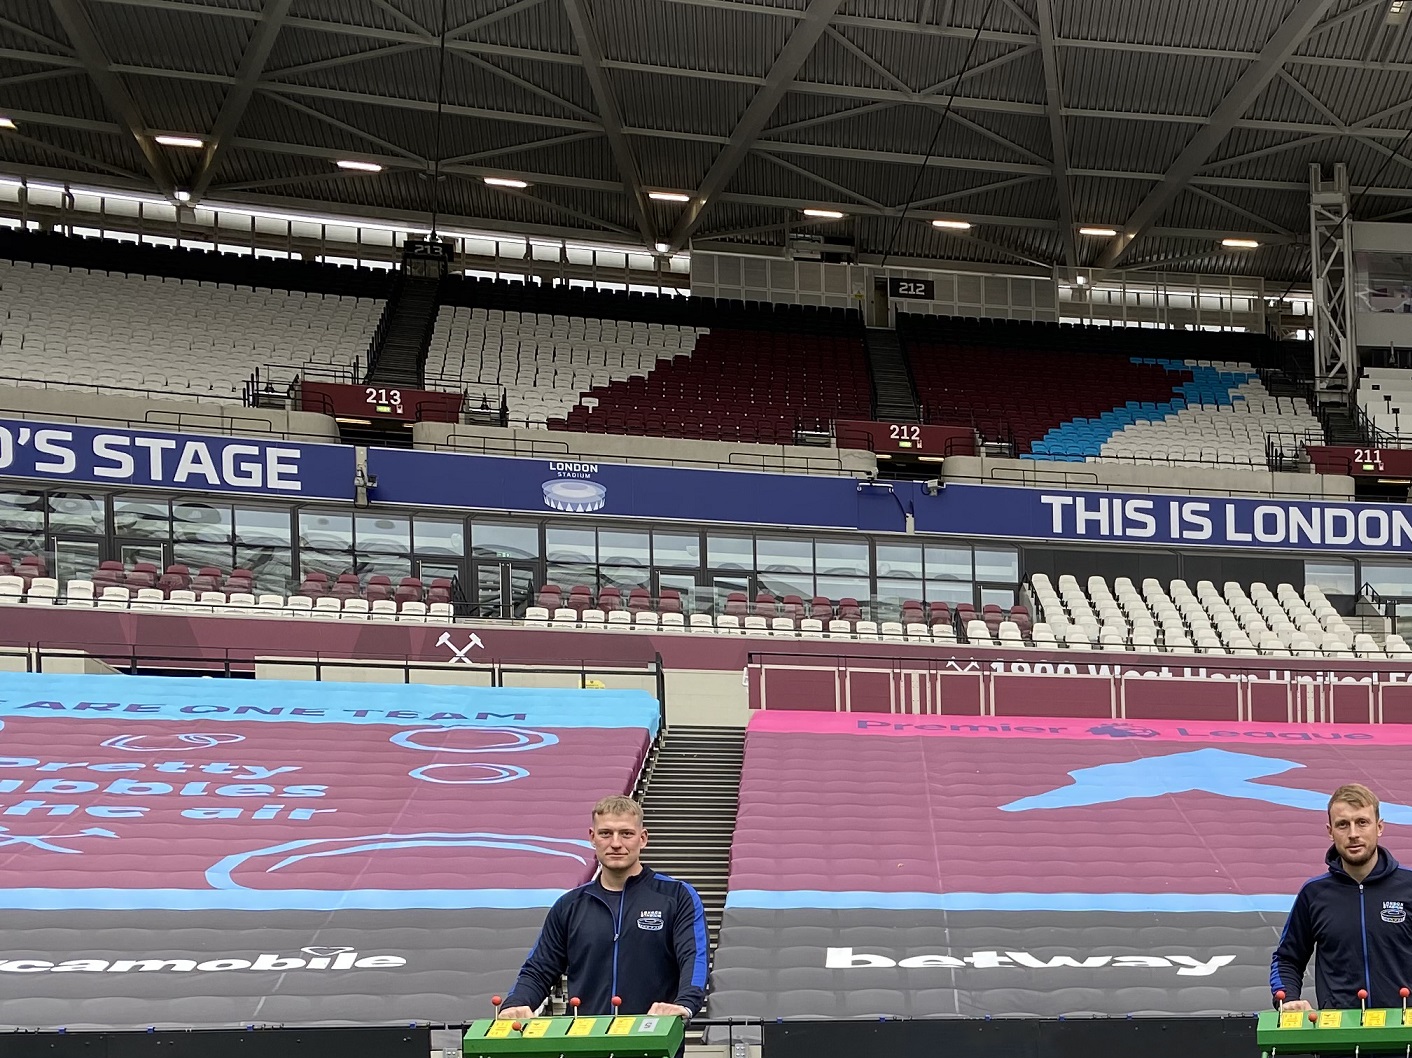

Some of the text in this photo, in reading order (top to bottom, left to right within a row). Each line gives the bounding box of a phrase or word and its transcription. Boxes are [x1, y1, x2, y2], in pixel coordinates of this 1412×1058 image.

[414, 244, 442, 256] 213
[899, 282, 925, 296] 212
[365, 387, 402, 405] 213
[889, 424, 921, 440] 212
[93, 434, 302, 491] STAGE
[1354, 448, 1382, 463] 211
[549, 461, 598, 473] LONDON
[557, 471, 591, 479] STADIUM
[1041, 494, 1157, 538] THIS
[1170, 499, 1212, 540] IS
[17, 700, 528, 721] ARE ONE TEAM
[857, 719, 1374, 741] Premier League
[0, 800, 338, 820] he air
[0, 947, 407, 973] camobile
[825, 946, 1238, 977] betway
